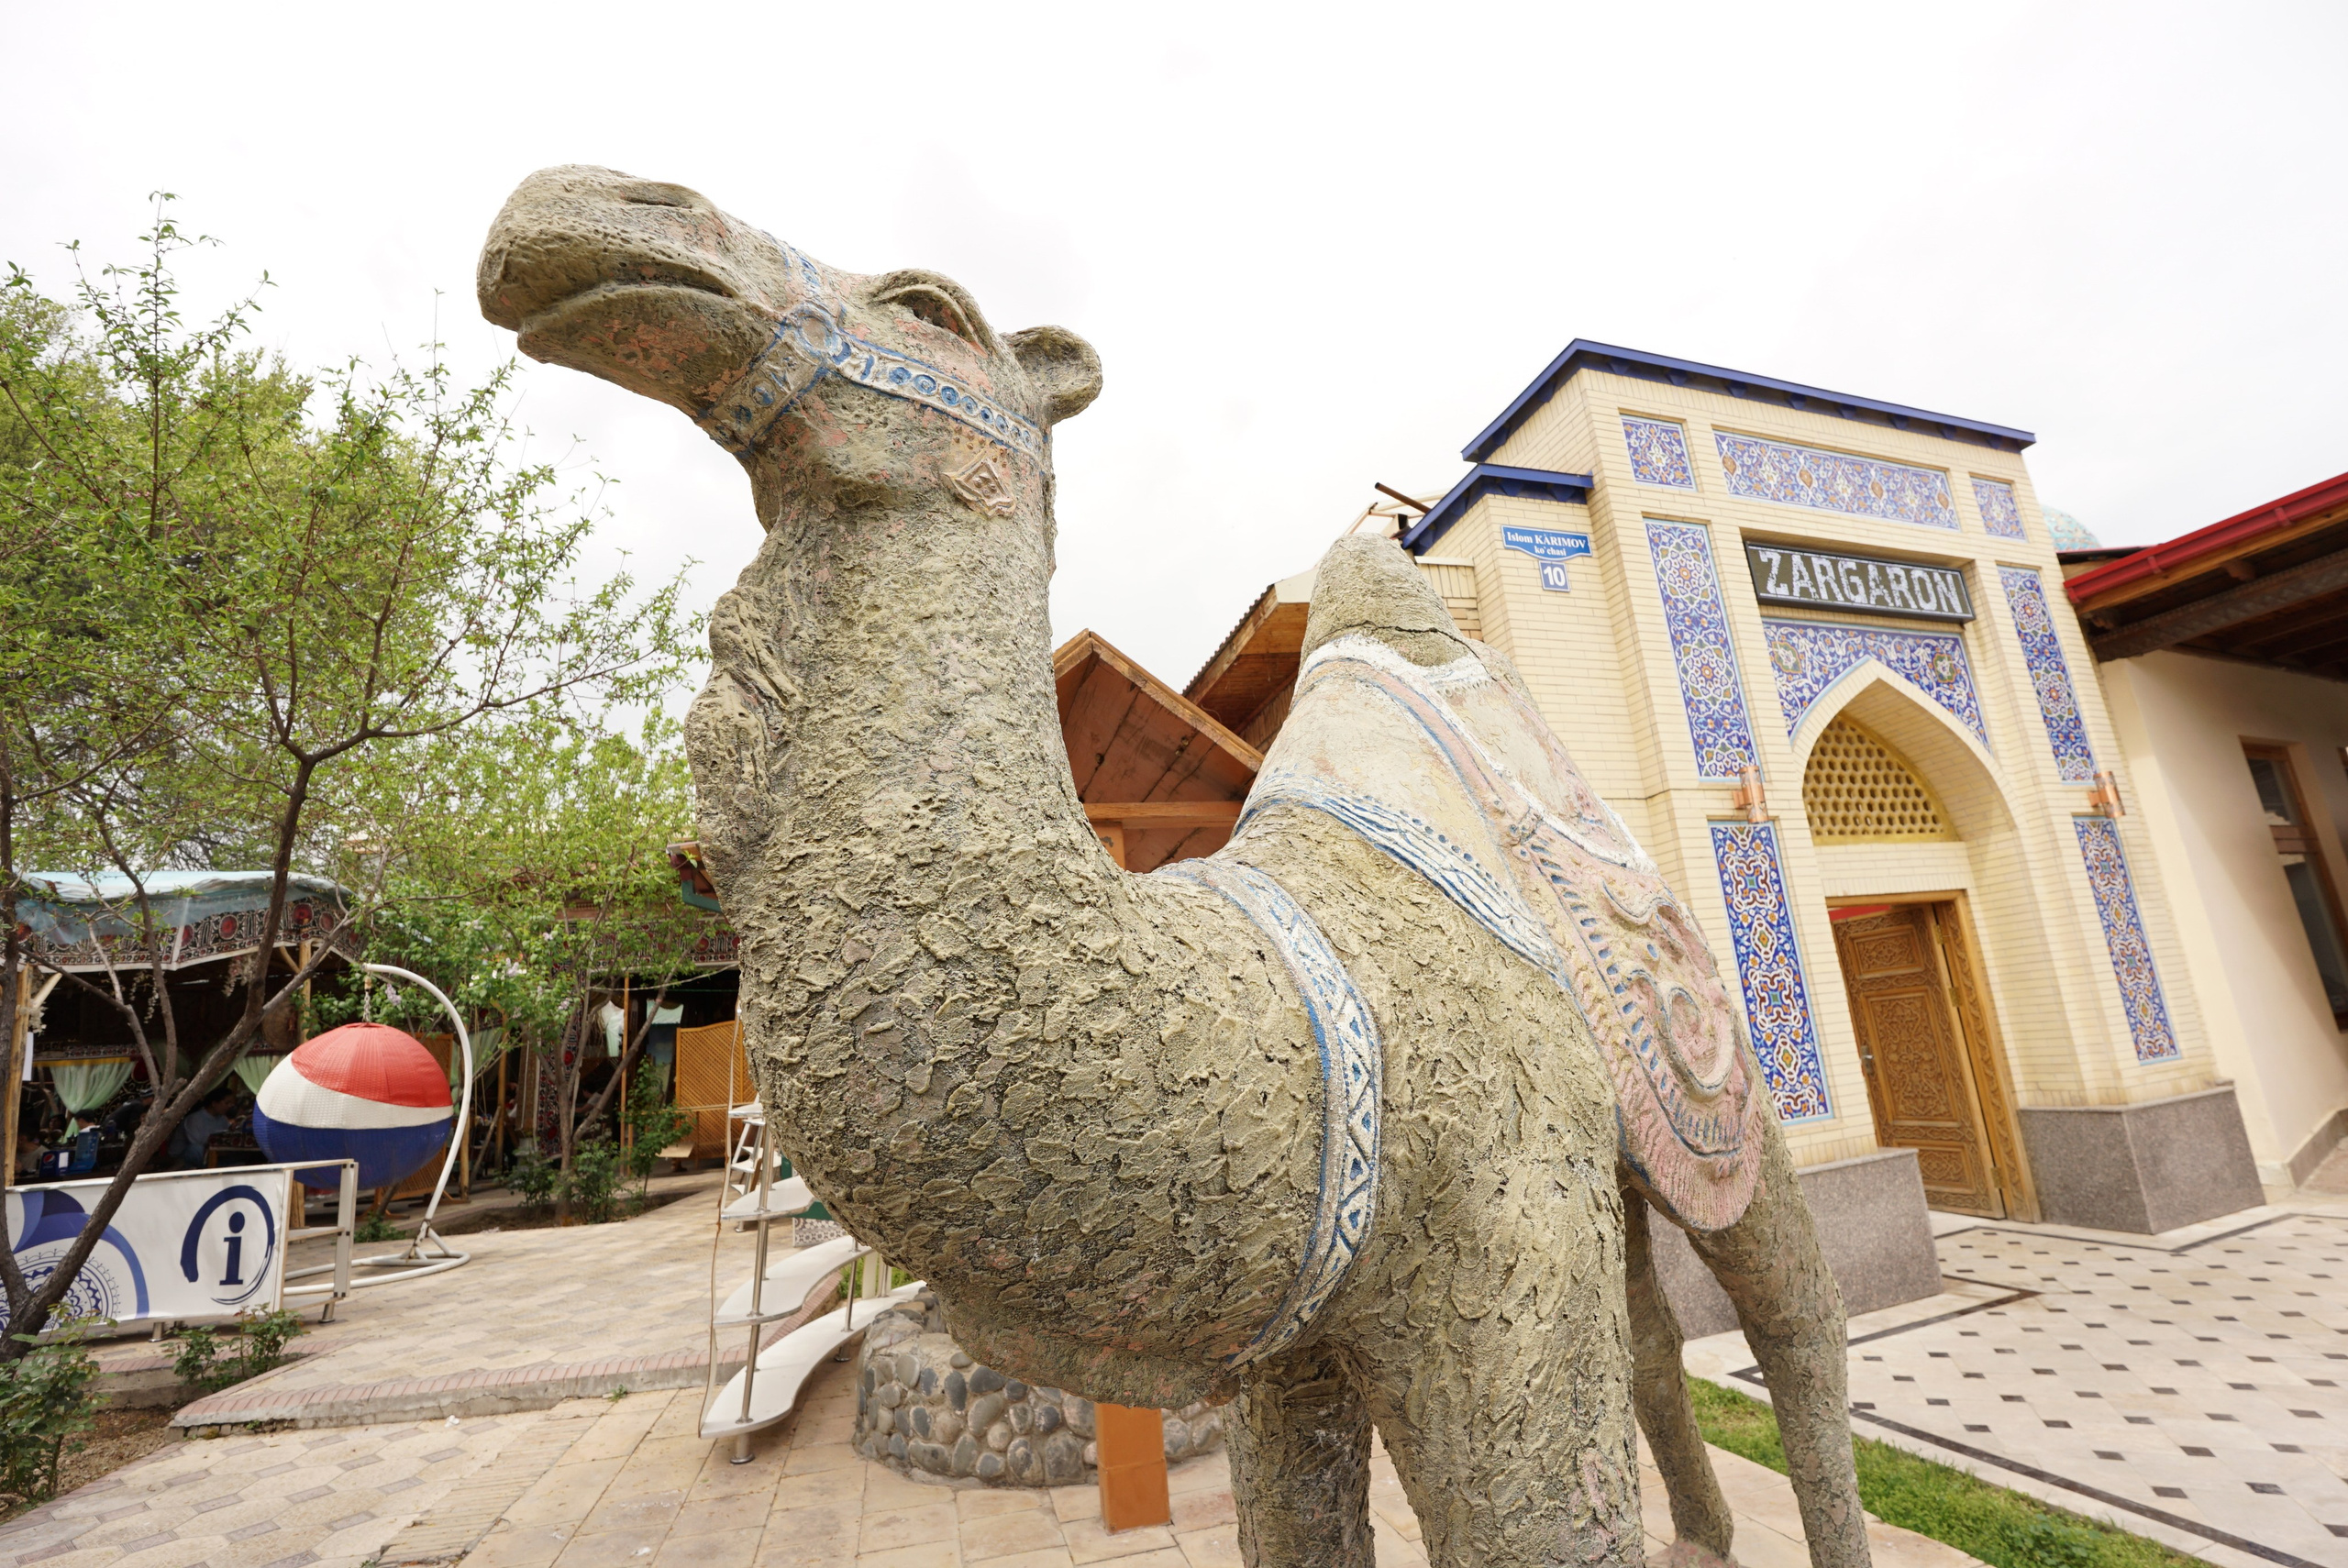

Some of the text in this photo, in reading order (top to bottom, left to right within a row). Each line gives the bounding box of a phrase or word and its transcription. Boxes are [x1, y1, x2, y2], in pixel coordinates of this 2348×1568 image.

[1506, 531, 1587, 548] Islom KARIMOV
[1543, 566, 1567, 587] 10
[1758, 550, 1963, 613] ZARGARON
